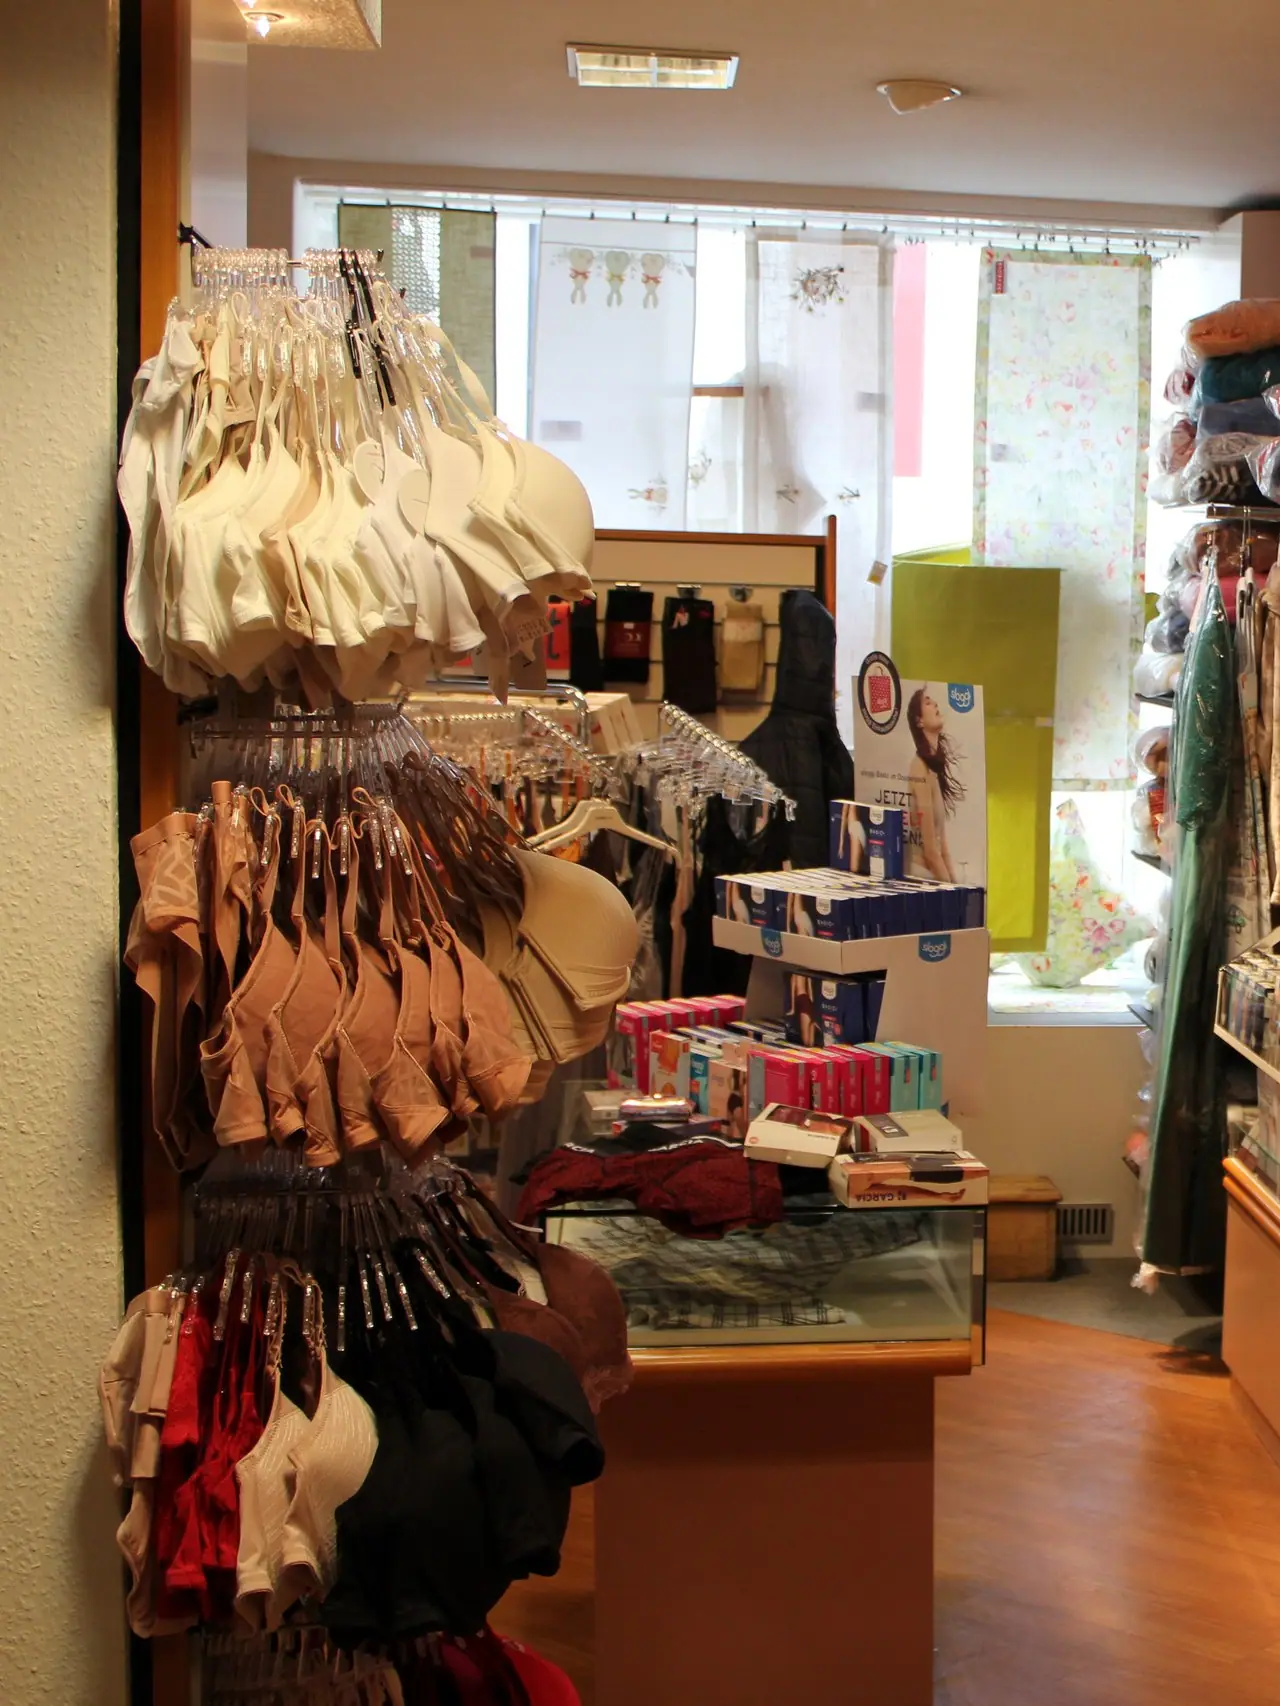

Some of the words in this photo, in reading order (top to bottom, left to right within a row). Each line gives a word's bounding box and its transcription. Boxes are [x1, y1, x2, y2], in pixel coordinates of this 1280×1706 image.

[875, 789, 913, 807] JETZT
[922, 942, 947, 958] sloggi
[856, 1191, 894, 1202] GARCIA
